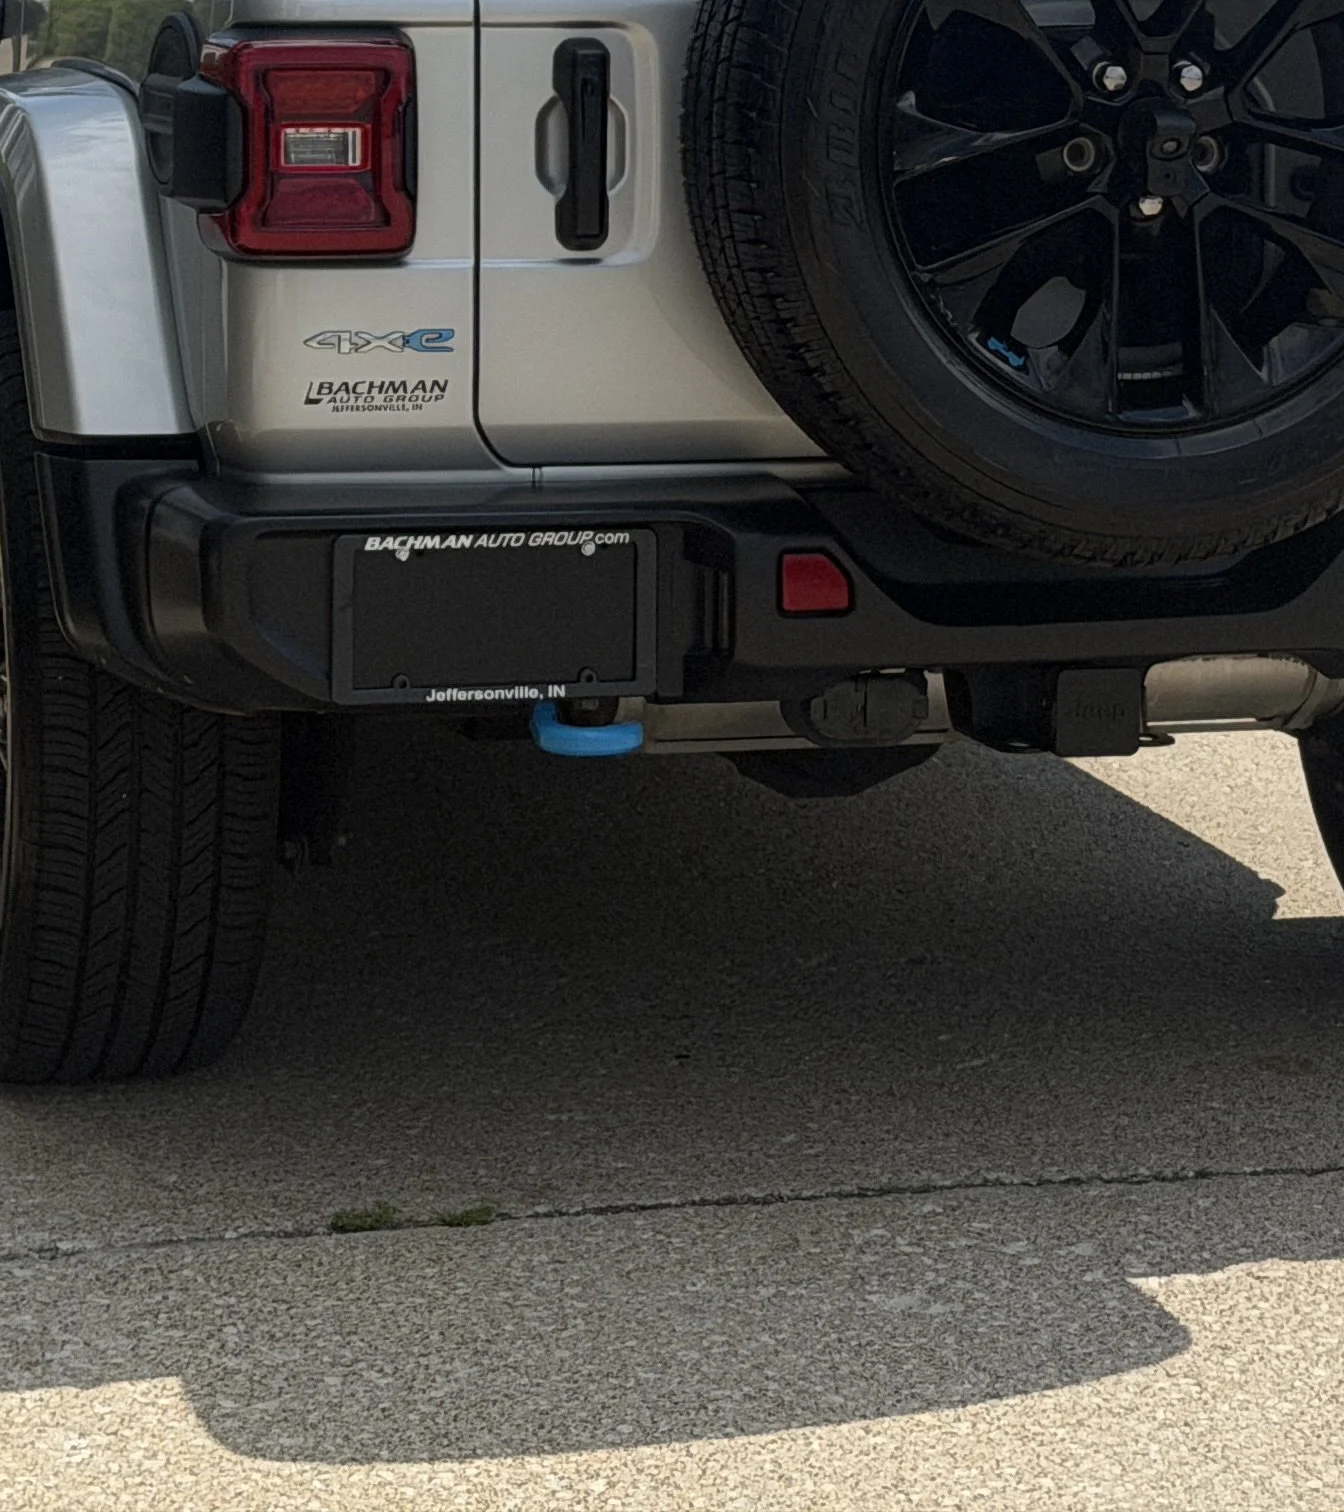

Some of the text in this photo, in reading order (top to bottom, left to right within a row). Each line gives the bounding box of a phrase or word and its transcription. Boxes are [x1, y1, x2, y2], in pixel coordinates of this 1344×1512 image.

[316, 379, 449, 396] BACHMAN
[326, 393, 445, 404] AUTO GROUP
[331, 403, 423, 413] JEFFERSONVILLE, IN
[364, 530, 630, 551] BACHMAN AUTO GROUPcom
[425, 684, 566, 702] Jeffersonville, IN
